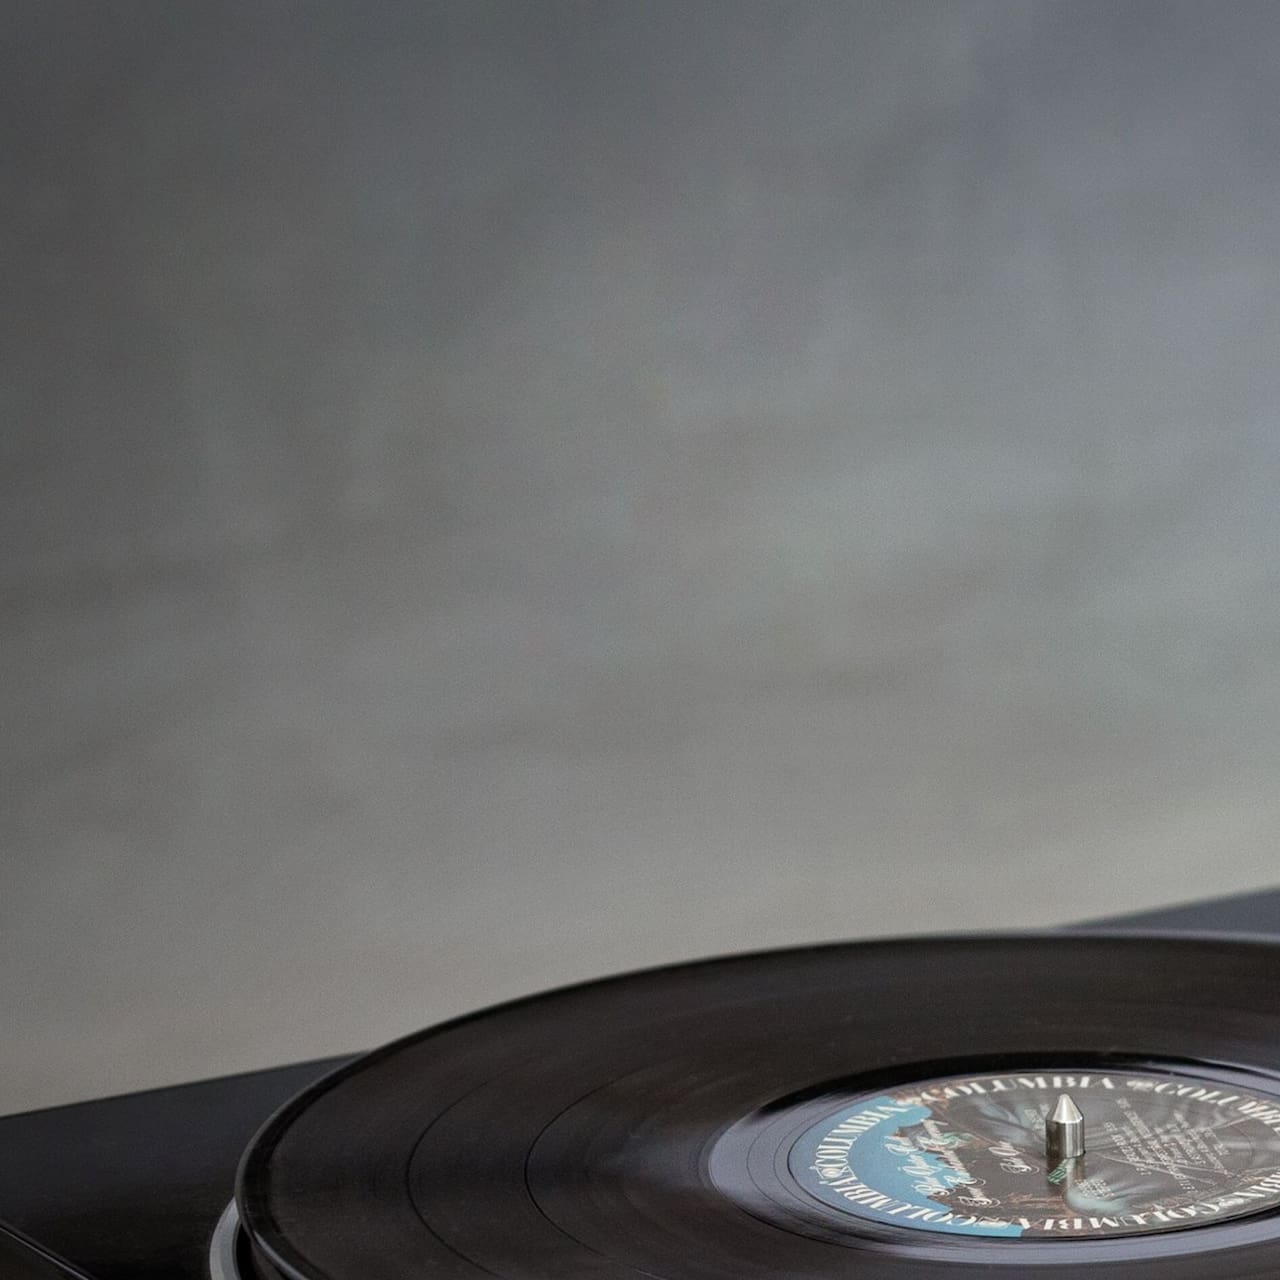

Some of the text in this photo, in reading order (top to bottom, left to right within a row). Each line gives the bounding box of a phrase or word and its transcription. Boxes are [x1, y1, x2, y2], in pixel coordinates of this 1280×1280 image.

[920, 1076, 1114, 1102] COLUMBIA
[815, 1105, 910, 1168] COLUMBIA
[829, 1179, 977, 1227] COLUMBIA
[1020, 1202, 1219, 1230] COLUMBIA
